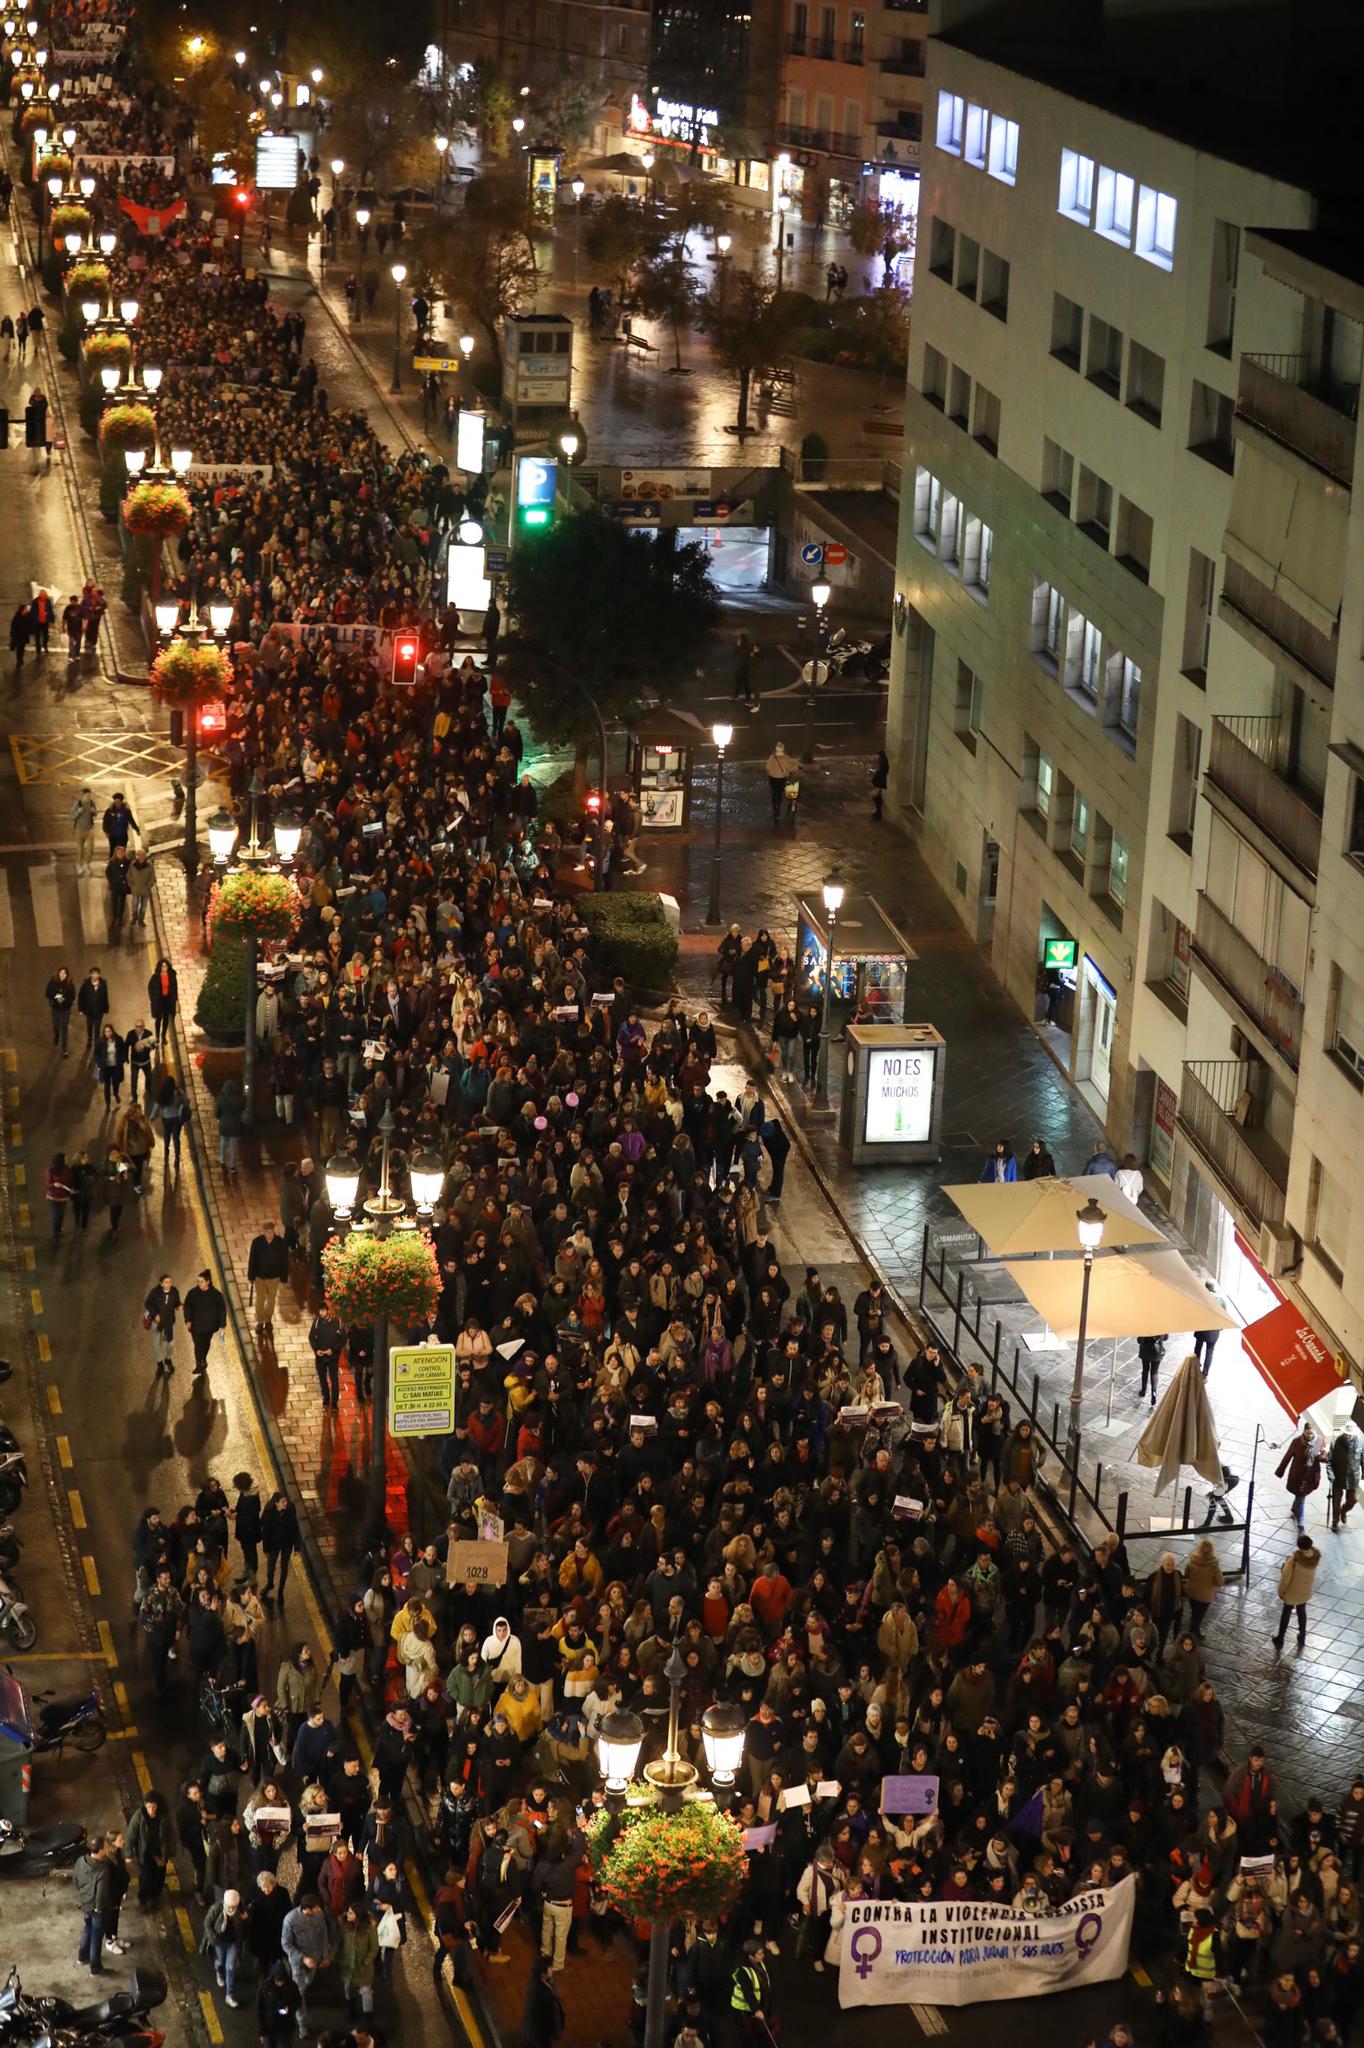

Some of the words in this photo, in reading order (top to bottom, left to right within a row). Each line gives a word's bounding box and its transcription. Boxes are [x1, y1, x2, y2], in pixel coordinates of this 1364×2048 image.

[883, 1058, 902, 1076] NO
[905, 1058, 922, 1076] ES
[881, 1086, 920, 1098] MUCHOS
[466, 1566, 489, 1580] 1028
[851, 1905, 912, 1924] CONTRA
[920, 1907, 938, 1923] LA
[945, 1905, 1027, 1923] VIOLENCIA
[921, 1924, 1041, 1945] INSTITUCIONAL
[895, 1946, 956, 1966] PROTECCIÓN
[959, 1945, 981, 1966] PARA
[1012, 1944, 1021, 1958] Y
[1022, 1943, 1039, 1959] SUS
